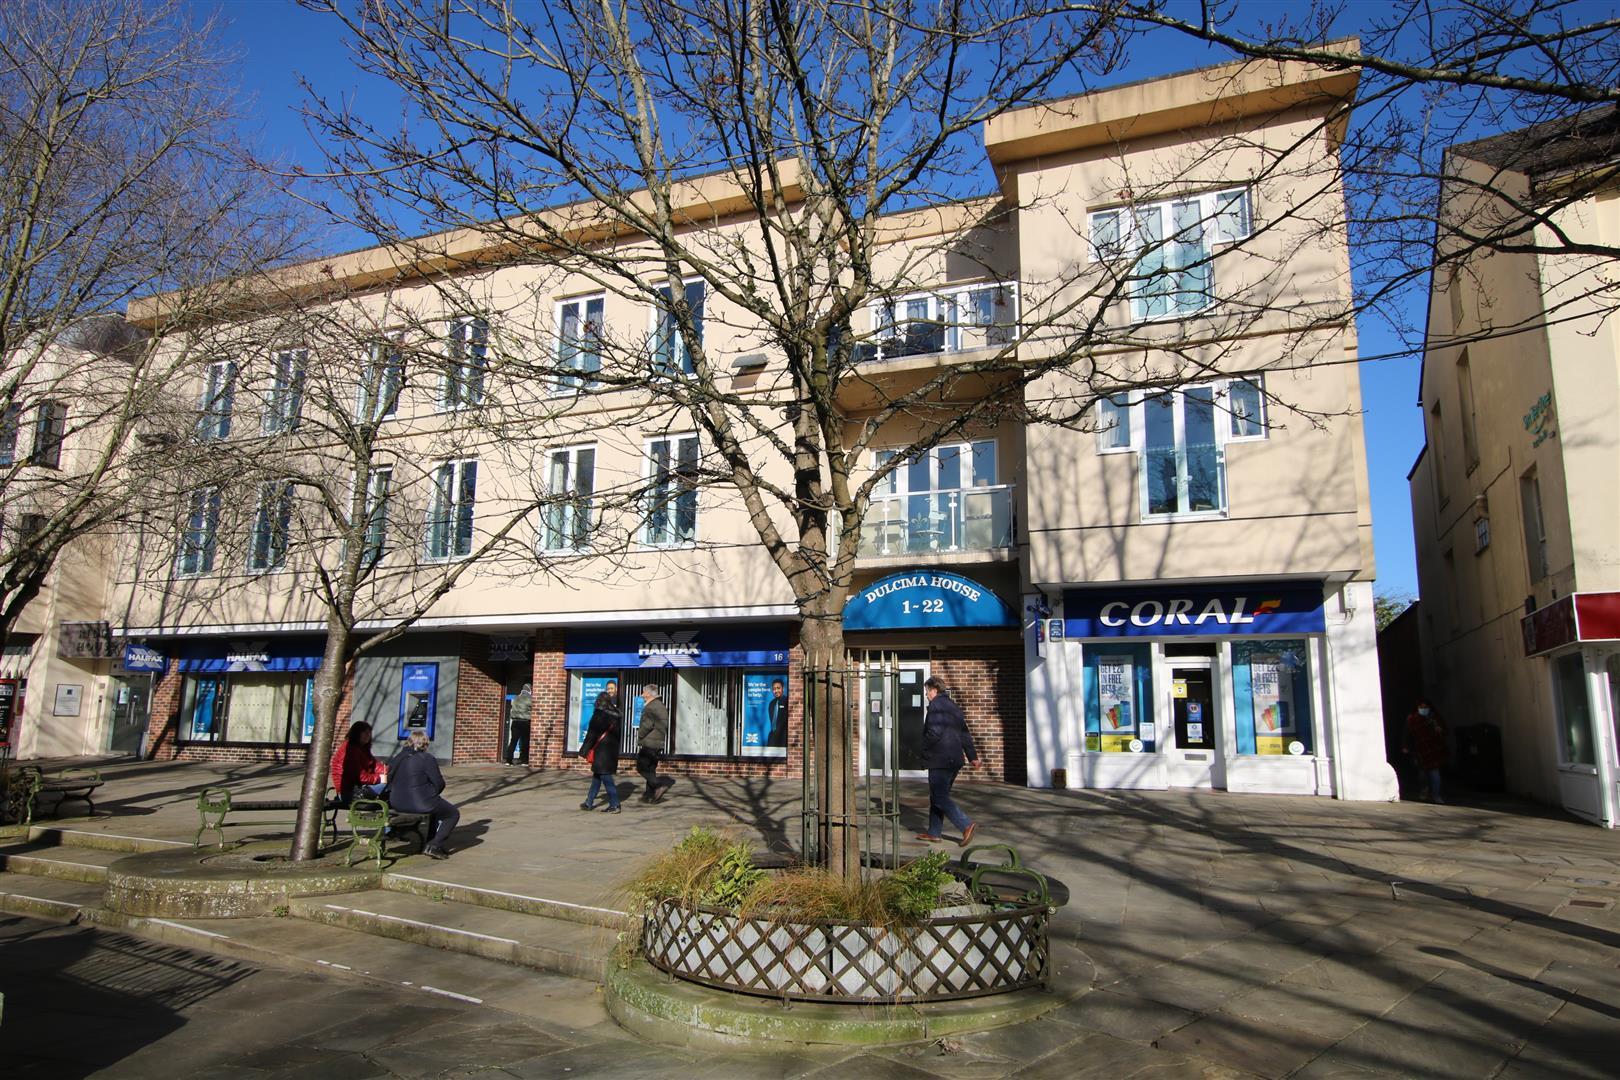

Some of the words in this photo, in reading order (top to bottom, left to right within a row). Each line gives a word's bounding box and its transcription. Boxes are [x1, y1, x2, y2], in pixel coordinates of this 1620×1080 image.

[865, 576, 927, 603] DULCIMA
[930, 576, 981, 602] HOUSE
[1099, 597, 1254, 627] CORAL
[489, 642, 528, 653] HALIFAX
[638, 642, 700, 655] HALIFAX
[128, 654, 163, 663] HALIFAX
[226, 651, 268, 662] HALIFAX
[774, 653, 784, 662] 16
[1101, 663, 1111, 673] GET
[1108, 674, 1122, 684] FREE
